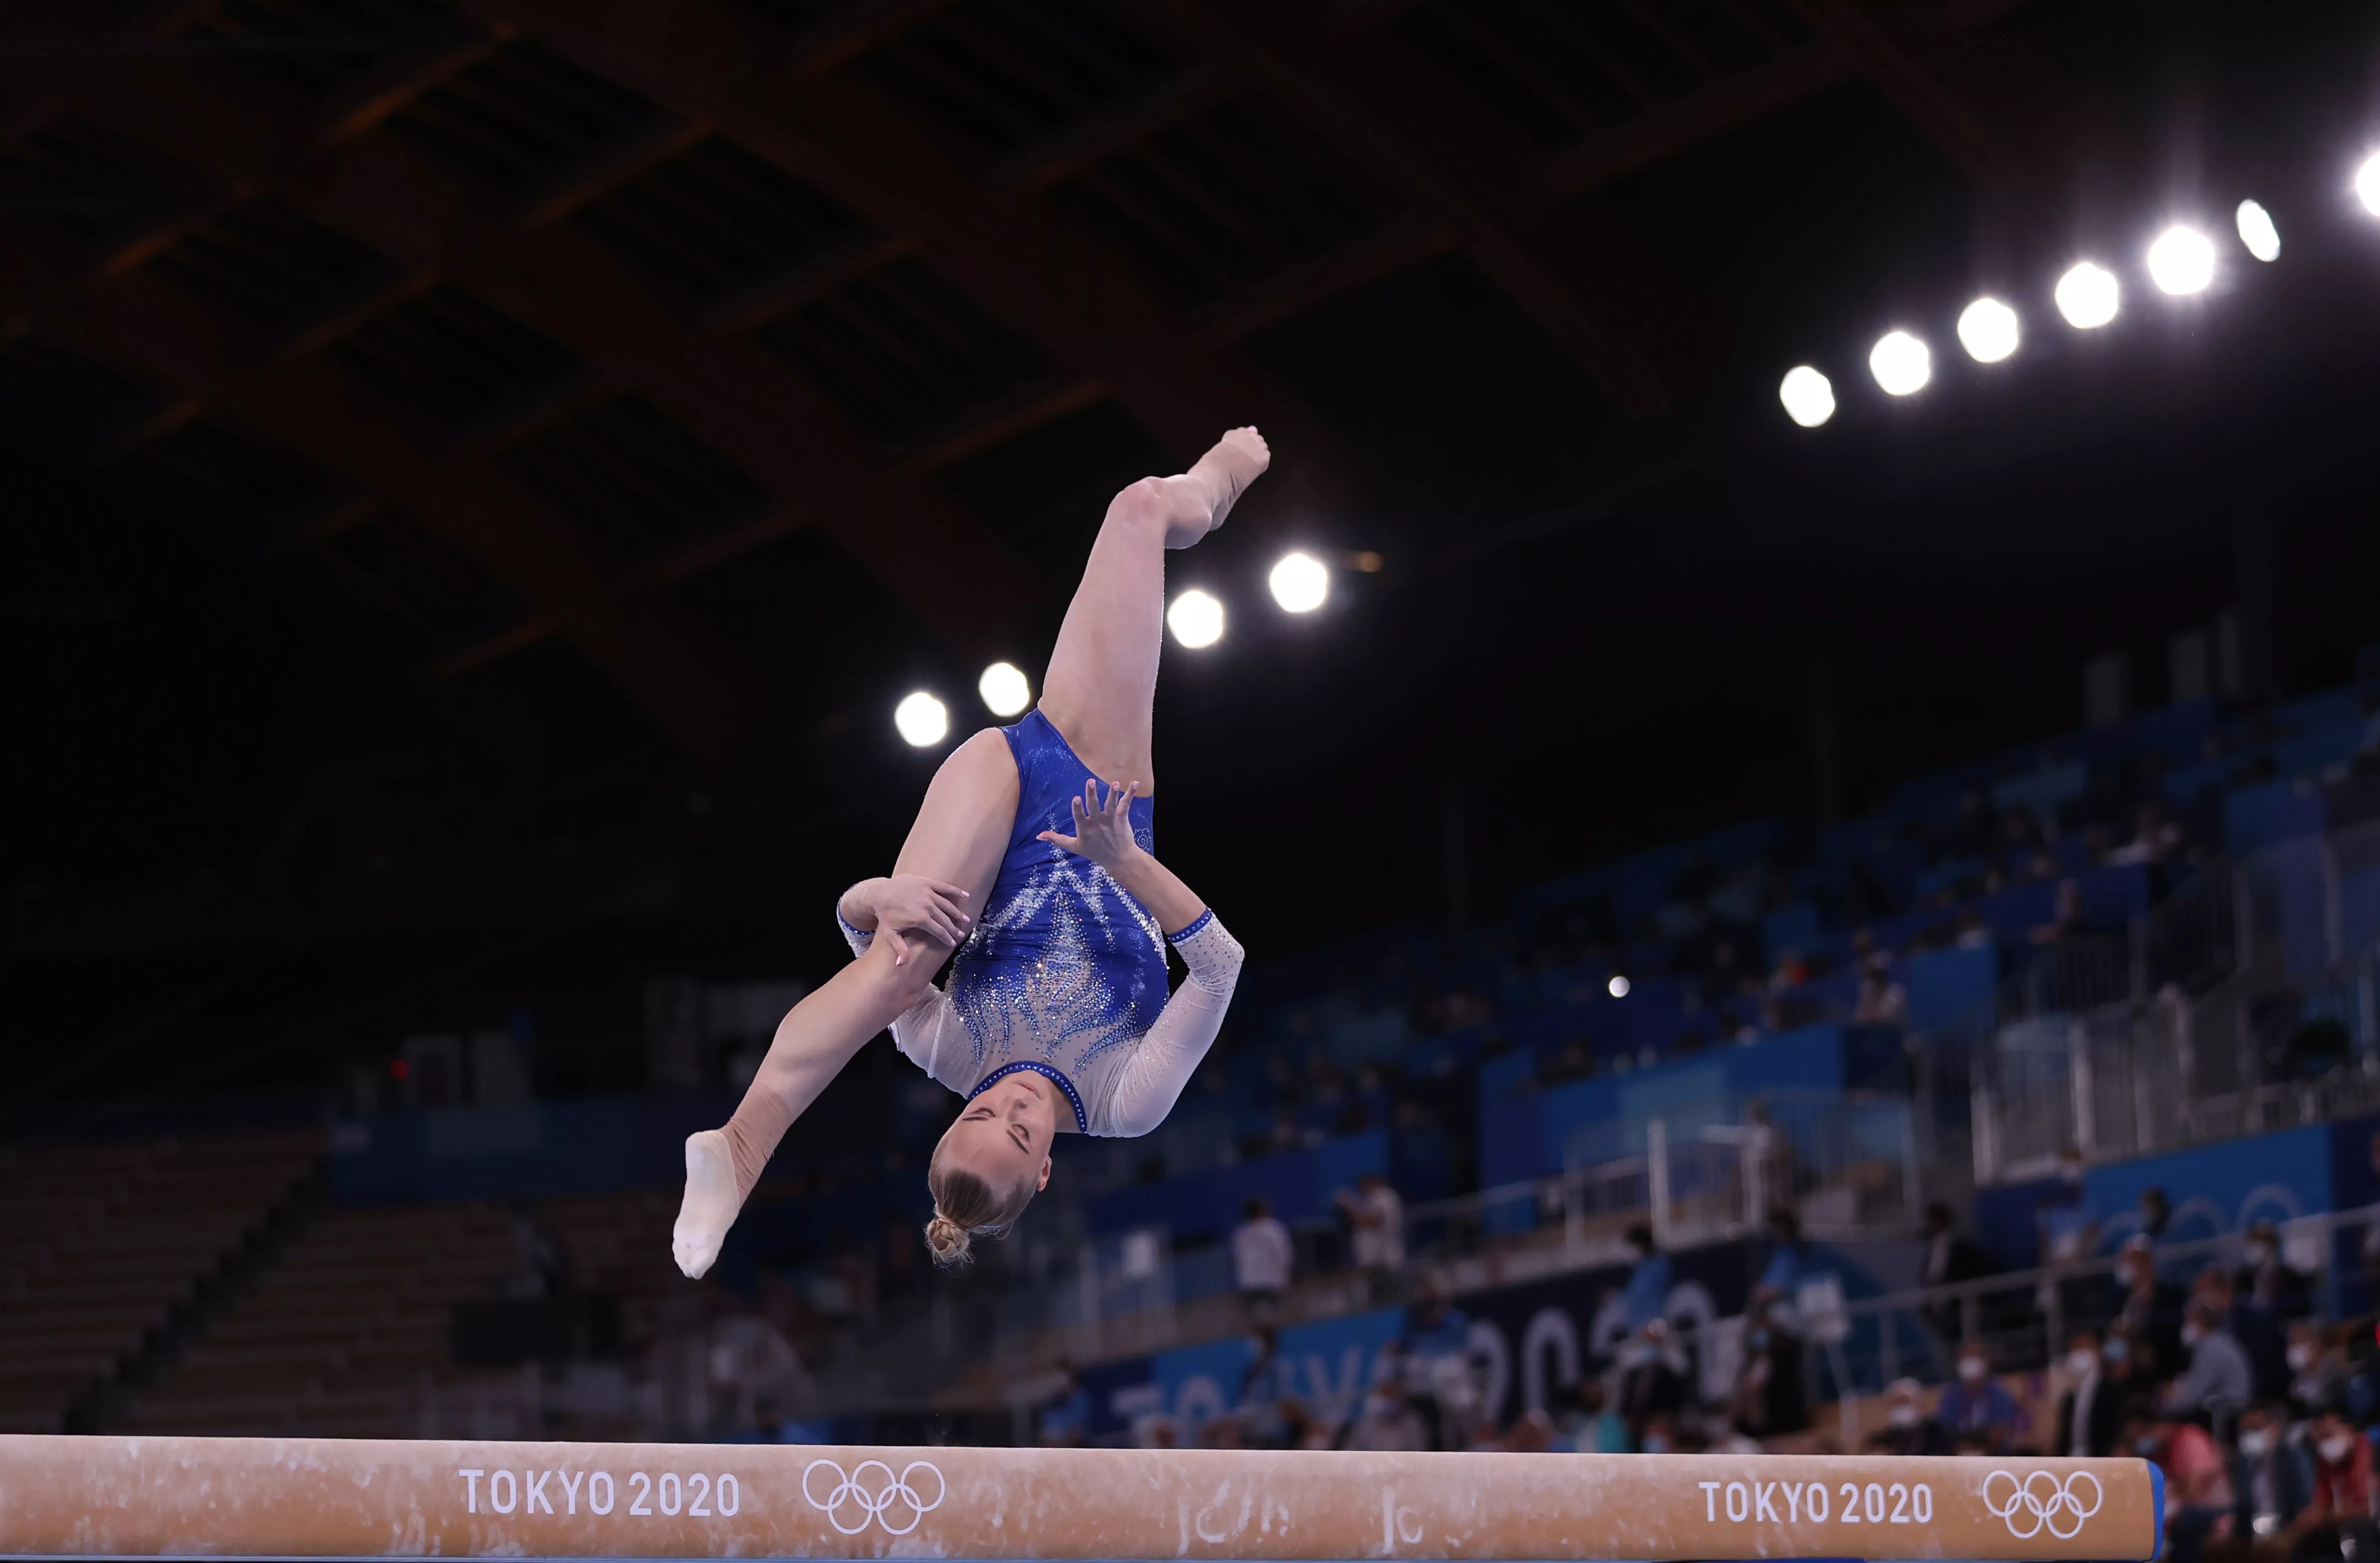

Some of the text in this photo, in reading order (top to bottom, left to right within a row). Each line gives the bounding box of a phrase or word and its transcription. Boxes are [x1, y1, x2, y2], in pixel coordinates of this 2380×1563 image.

[457, 1468, 741, 1518] TOKYO 2020
[1698, 1481, 1933, 1524] TOKYO 2020
